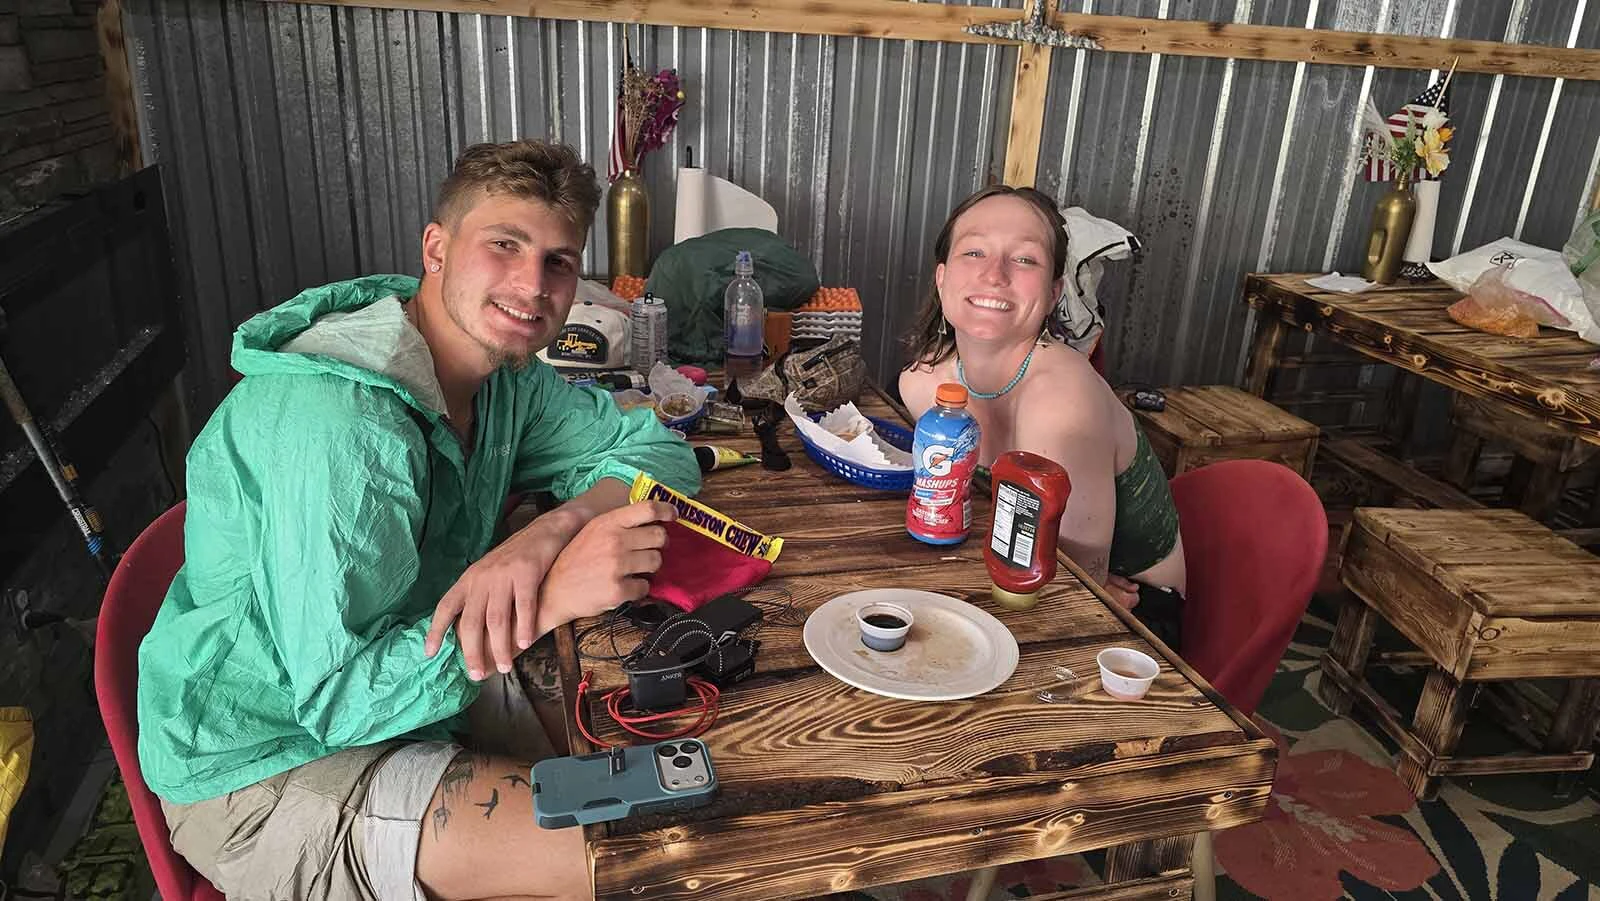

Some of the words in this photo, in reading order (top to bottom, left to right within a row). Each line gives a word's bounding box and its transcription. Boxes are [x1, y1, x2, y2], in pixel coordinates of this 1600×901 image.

[922, 445, 955, 476] G
[916, 477, 959, 489] MASHUPS
[726, 524, 763, 555] CHEW
